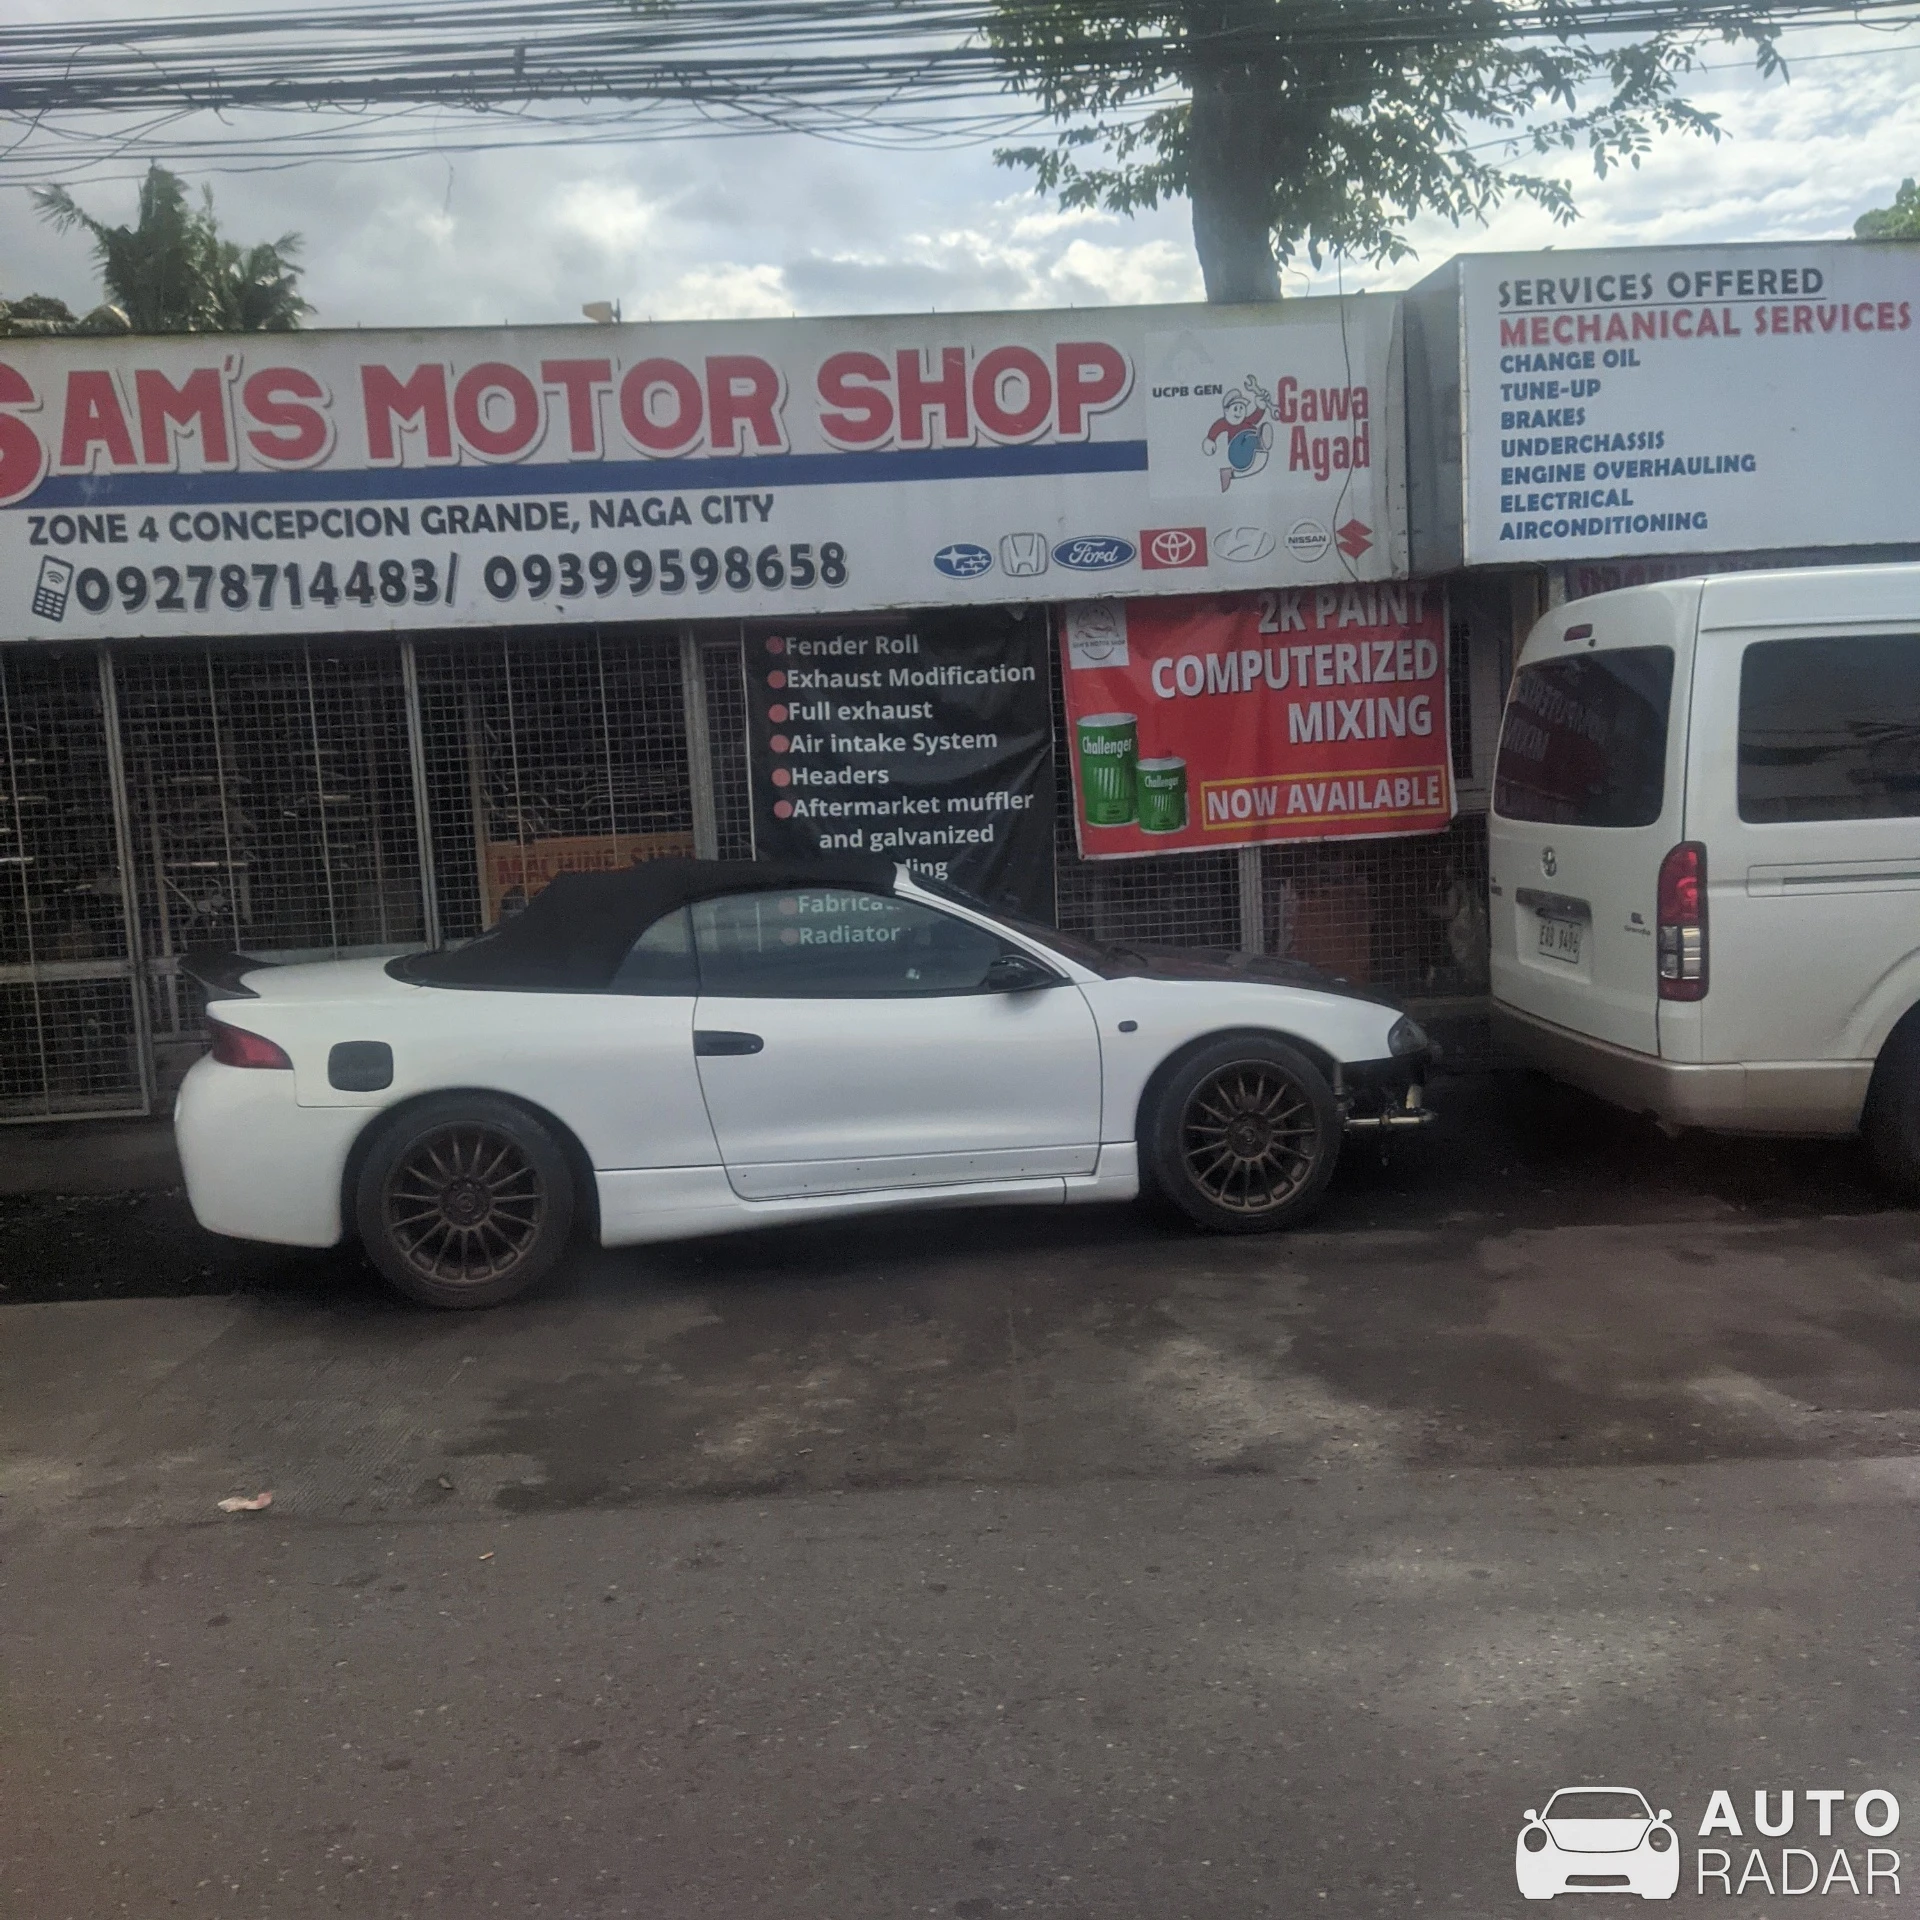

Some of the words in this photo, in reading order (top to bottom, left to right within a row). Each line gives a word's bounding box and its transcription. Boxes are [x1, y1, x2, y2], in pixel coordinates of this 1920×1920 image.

[1498, 272, 1653, 308] SERVICES
[1667, 268, 1825, 298] OFFERED
[1499, 307, 1741, 347] MECHANICAL
[1754, 301, 1911, 336] SERVICES
[1500, 350, 1595, 374] CHANGE
[1603, 348, 1640, 368] OIL
[360, 354, 786, 463] MOTOR
[817, 341, 1130, 445] SHOP
[1152, 385, 1189, 398] UCPB
[1193, 384, 1223, 396] GEN
[1277, 376, 1369, 424] Gawa
[1500, 379, 1601, 402] TUNE-UP
[1500, 407, 1586, 430] BRAKES
[1288, 422, 1370, 482] Agad
[1501, 431, 1665, 457] UNDERCHASSIS
[1501, 463, 1586, 485] ENGINE
[1593, 454, 1756, 481] OVERHAULING
[1501, 489, 1634, 513] ELECTRICAL
[28, 514, 127, 545] ZONE
[138, 515, 159, 542] 4
[169, 507, 410, 543] CONCEPCION
[420, 501, 580, 536] GRANDE,
[590, 496, 692, 529] NAGA
[701, 494, 775, 525] CITY
[1499, 512, 1709, 540] AIRCONDITIONING
[1067, 540, 1119, 565] Ford
[1287, 534, 1327, 546] NISSAN
[484, 541, 847, 602] 09399598658
[1258, 590, 1307, 634] 2K
[1315, 583, 1427, 630] PAINT
[785, 635, 868, 656] Fender
[876, 634, 919, 654] Roll
[787, 669, 881, 688] Exhaust
[888, 665, 1036, 688] Modification
[1151, 639, 1438, 699] COMPUTERIZED
[789, 701, 831, 721] Full
[837, 701, 933, 720] exhaust
[1288, 695, 1433, 745] MIXING
[788, 735, 823, 753] Air
[831, 733, 906, 753] intake
[913, 732, 998, 756] System
[1082, 735, 1132, 758] Challenger
[792, 766, 890, 785] Headers
[1144, 775, 1179, 790] Challenger
[792, 796, 939, 818] Aftermarket
[947, 791, 1034, 813] muffler
[1207, 785, 1278, 821] NOW
[1286, 776, 1441, 815] AVAILABLE
[819, 829, 863, 849] and
[870, 824, 995, 852] galvanized
[800, 925, 901, 945] Radiator
